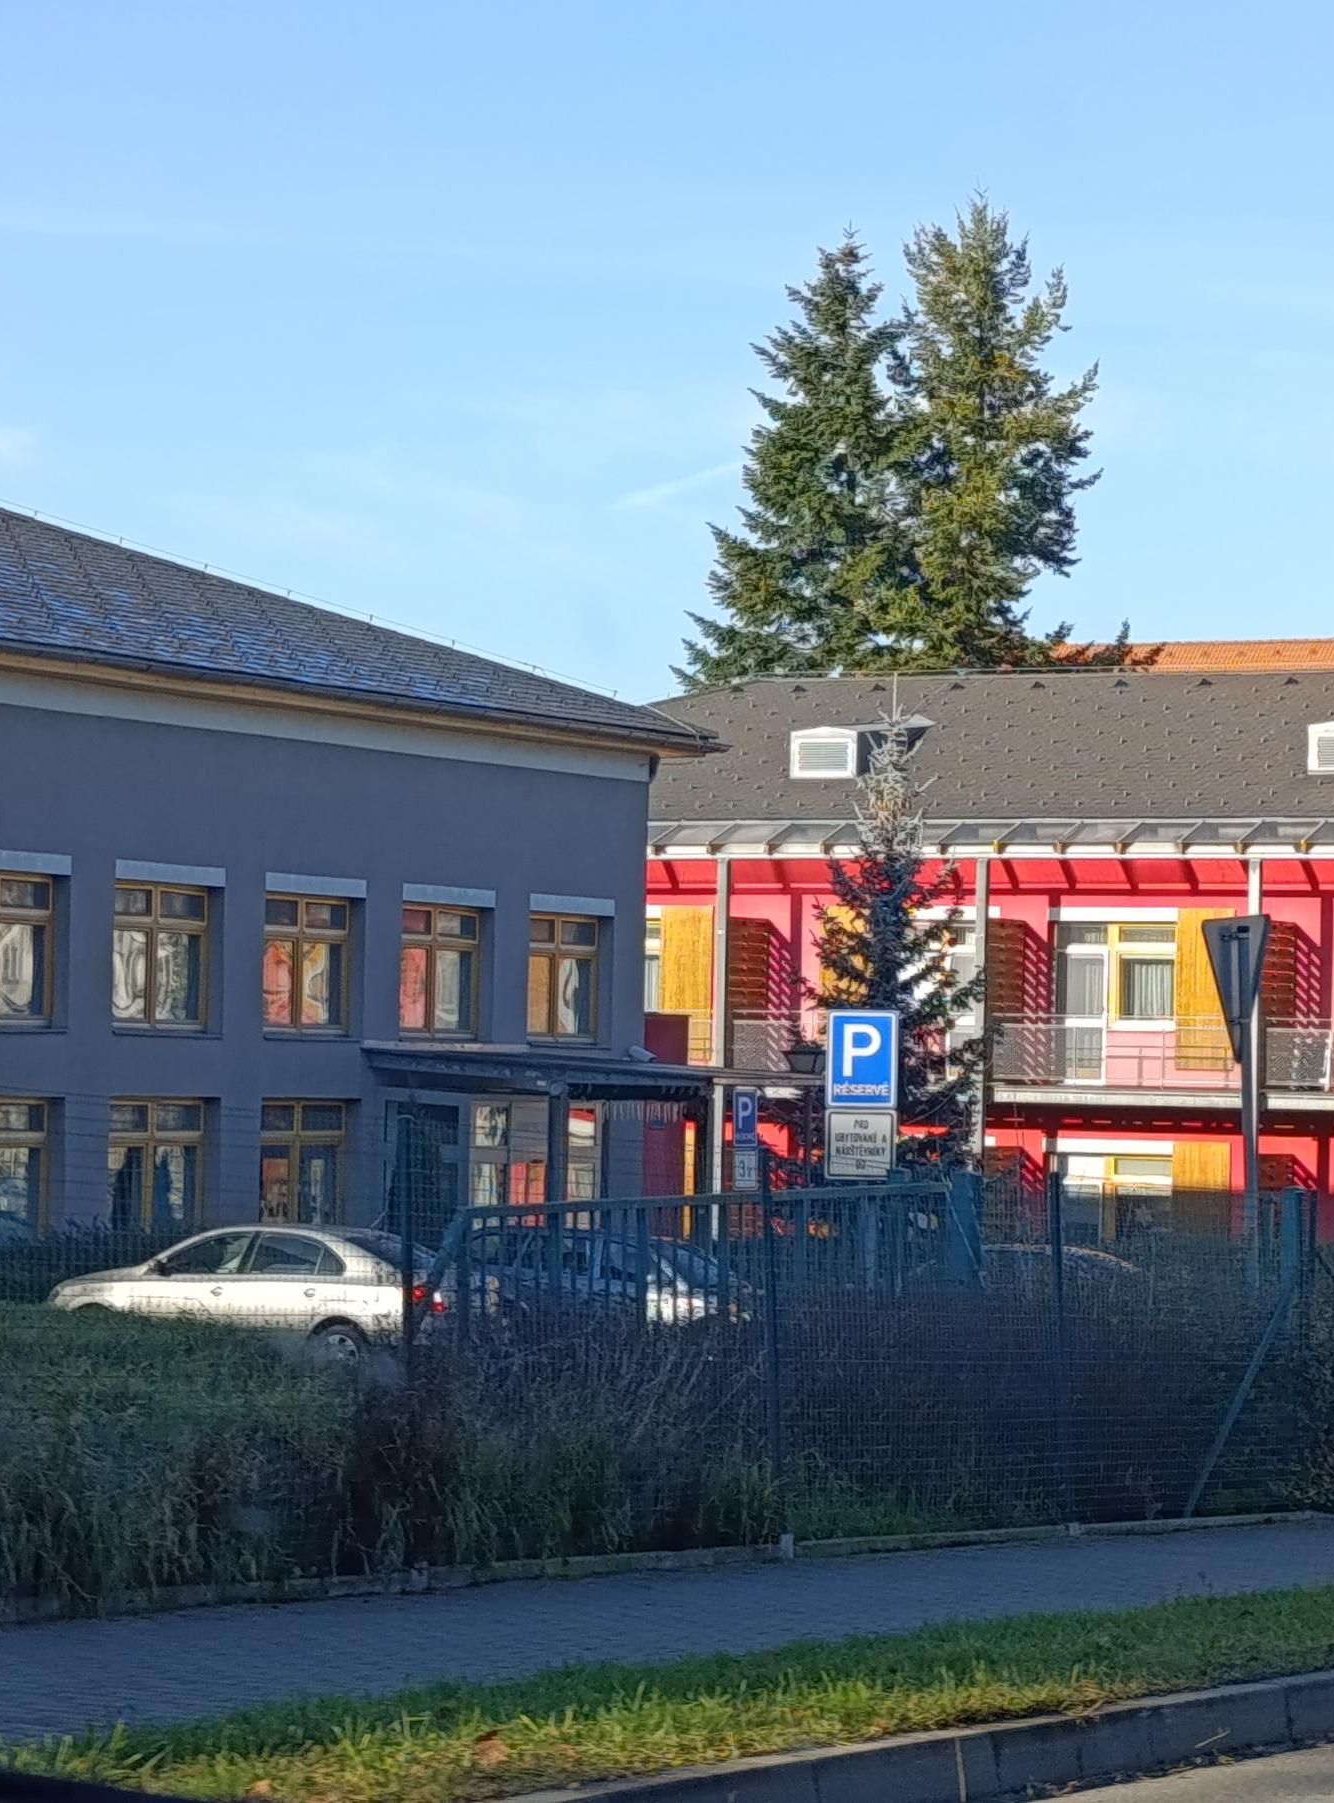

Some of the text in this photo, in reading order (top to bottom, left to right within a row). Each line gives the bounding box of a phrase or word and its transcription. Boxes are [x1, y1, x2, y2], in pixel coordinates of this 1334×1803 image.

[843, 1023, 882, 1077] P
[834, 1081, 890, 1096] RÉSERVÉ
[739, 1096, 752, 1129] P
[854, 1120, 869, 1129] PRO
[882, 1134, 888, 1144] A
